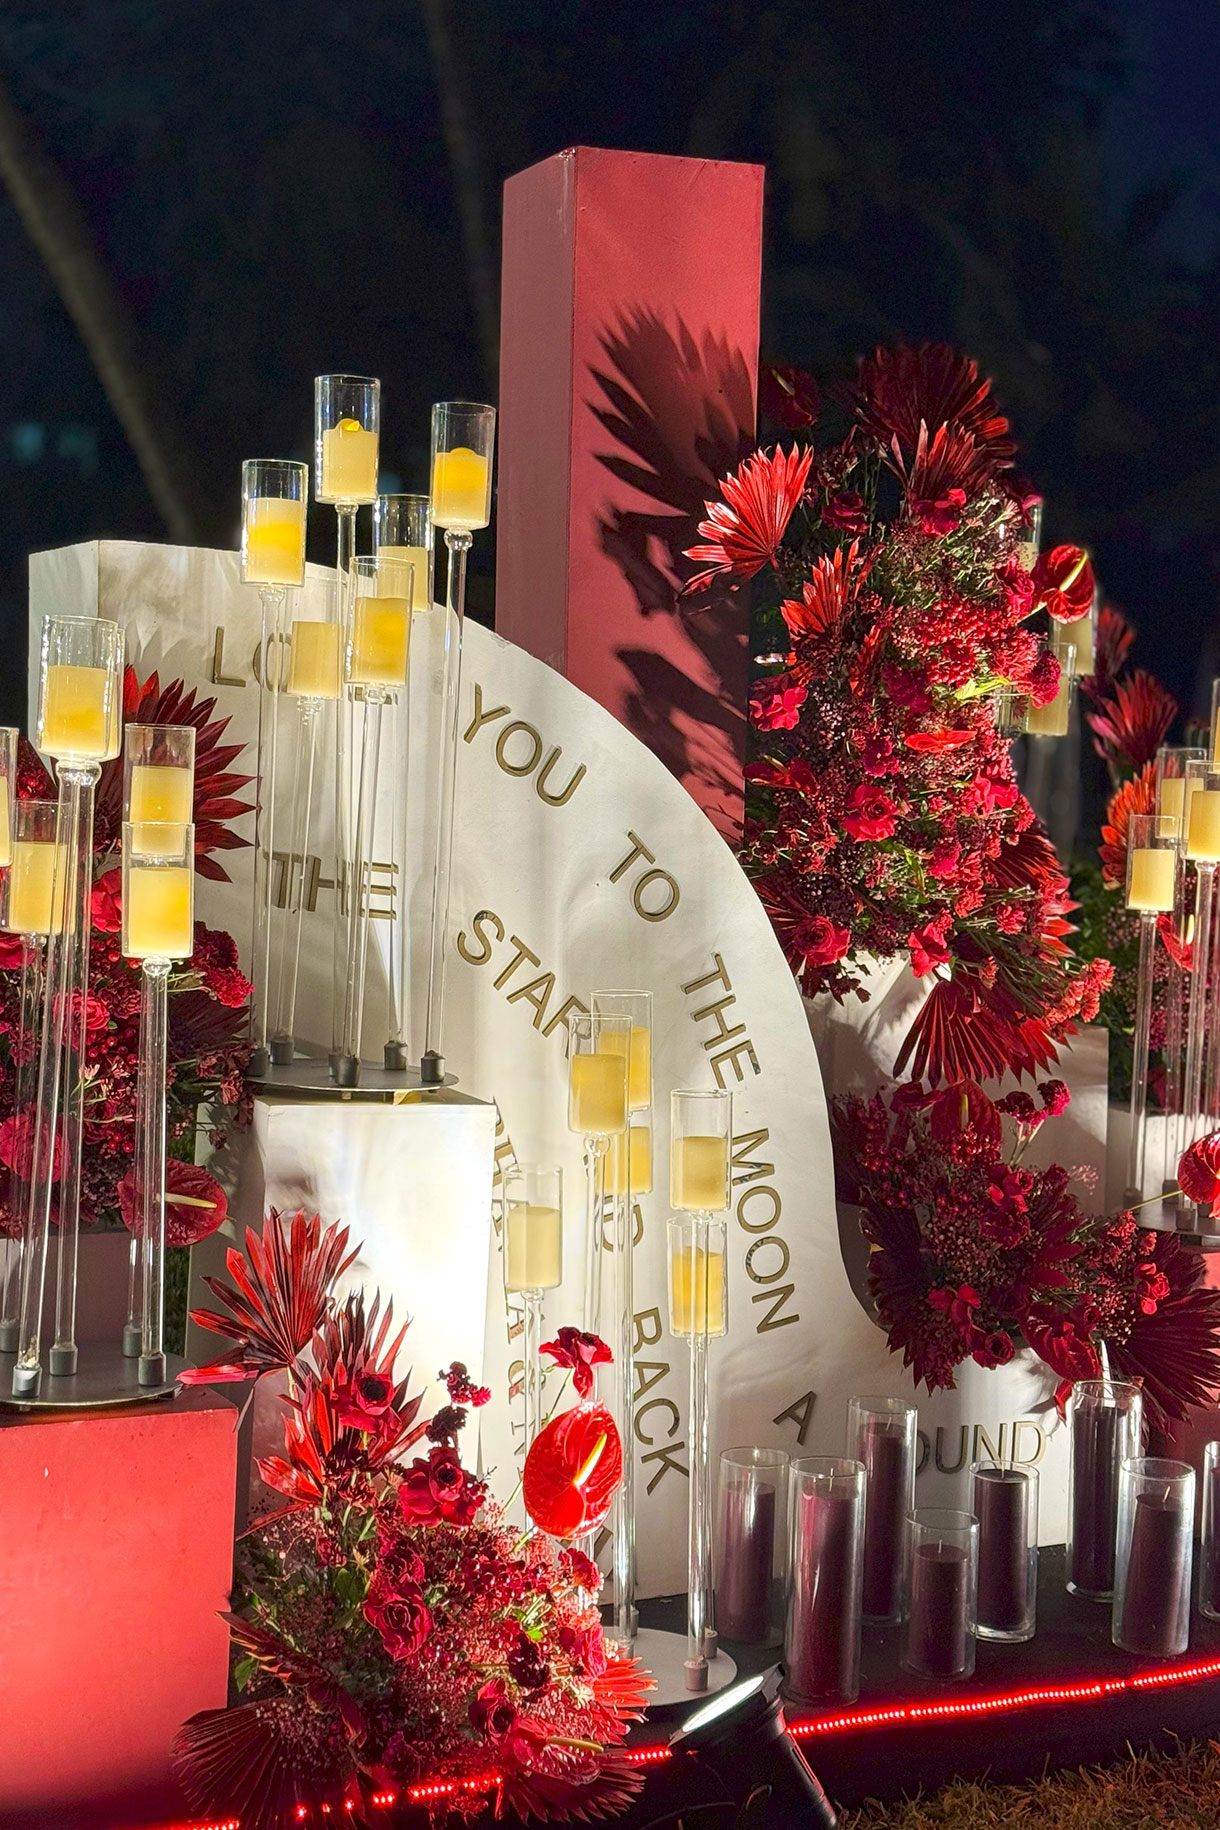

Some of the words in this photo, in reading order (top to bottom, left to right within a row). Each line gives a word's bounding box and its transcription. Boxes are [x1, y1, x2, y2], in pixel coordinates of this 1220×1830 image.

[262, 849, 400, 920] THE
[456, 909, 601, 1061] STAR
[631, 1306, 690, 1496] BACK
[463, 683, 587, 807] YOU
[609, 829, 680, 923] TO
[681, 953, 761, 1090] THE
[731, 1128, 800, 1334] MOON
